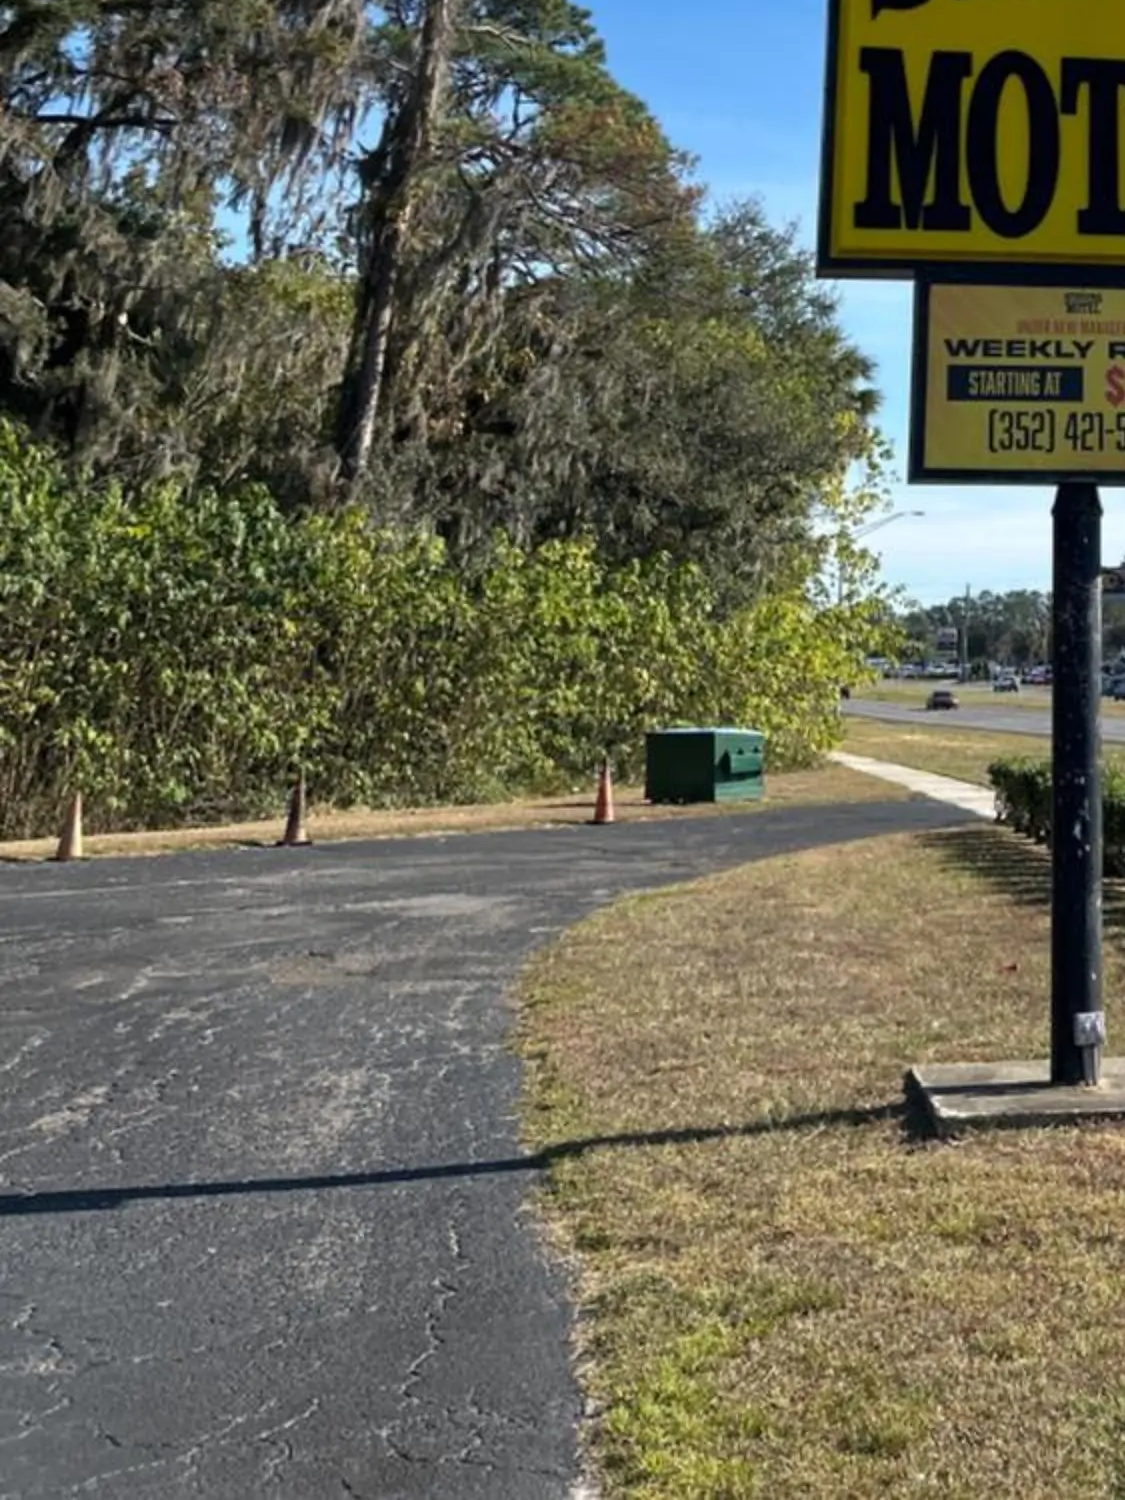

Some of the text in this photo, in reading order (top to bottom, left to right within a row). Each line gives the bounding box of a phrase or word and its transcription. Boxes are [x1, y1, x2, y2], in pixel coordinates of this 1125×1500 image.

[944, 338, 1095, 358] WEEKLY
[968, 370, 1041, 397] STARTING
[1044, 371, 1063, 397] AT
[988, 408, 1055, 453] (352)
